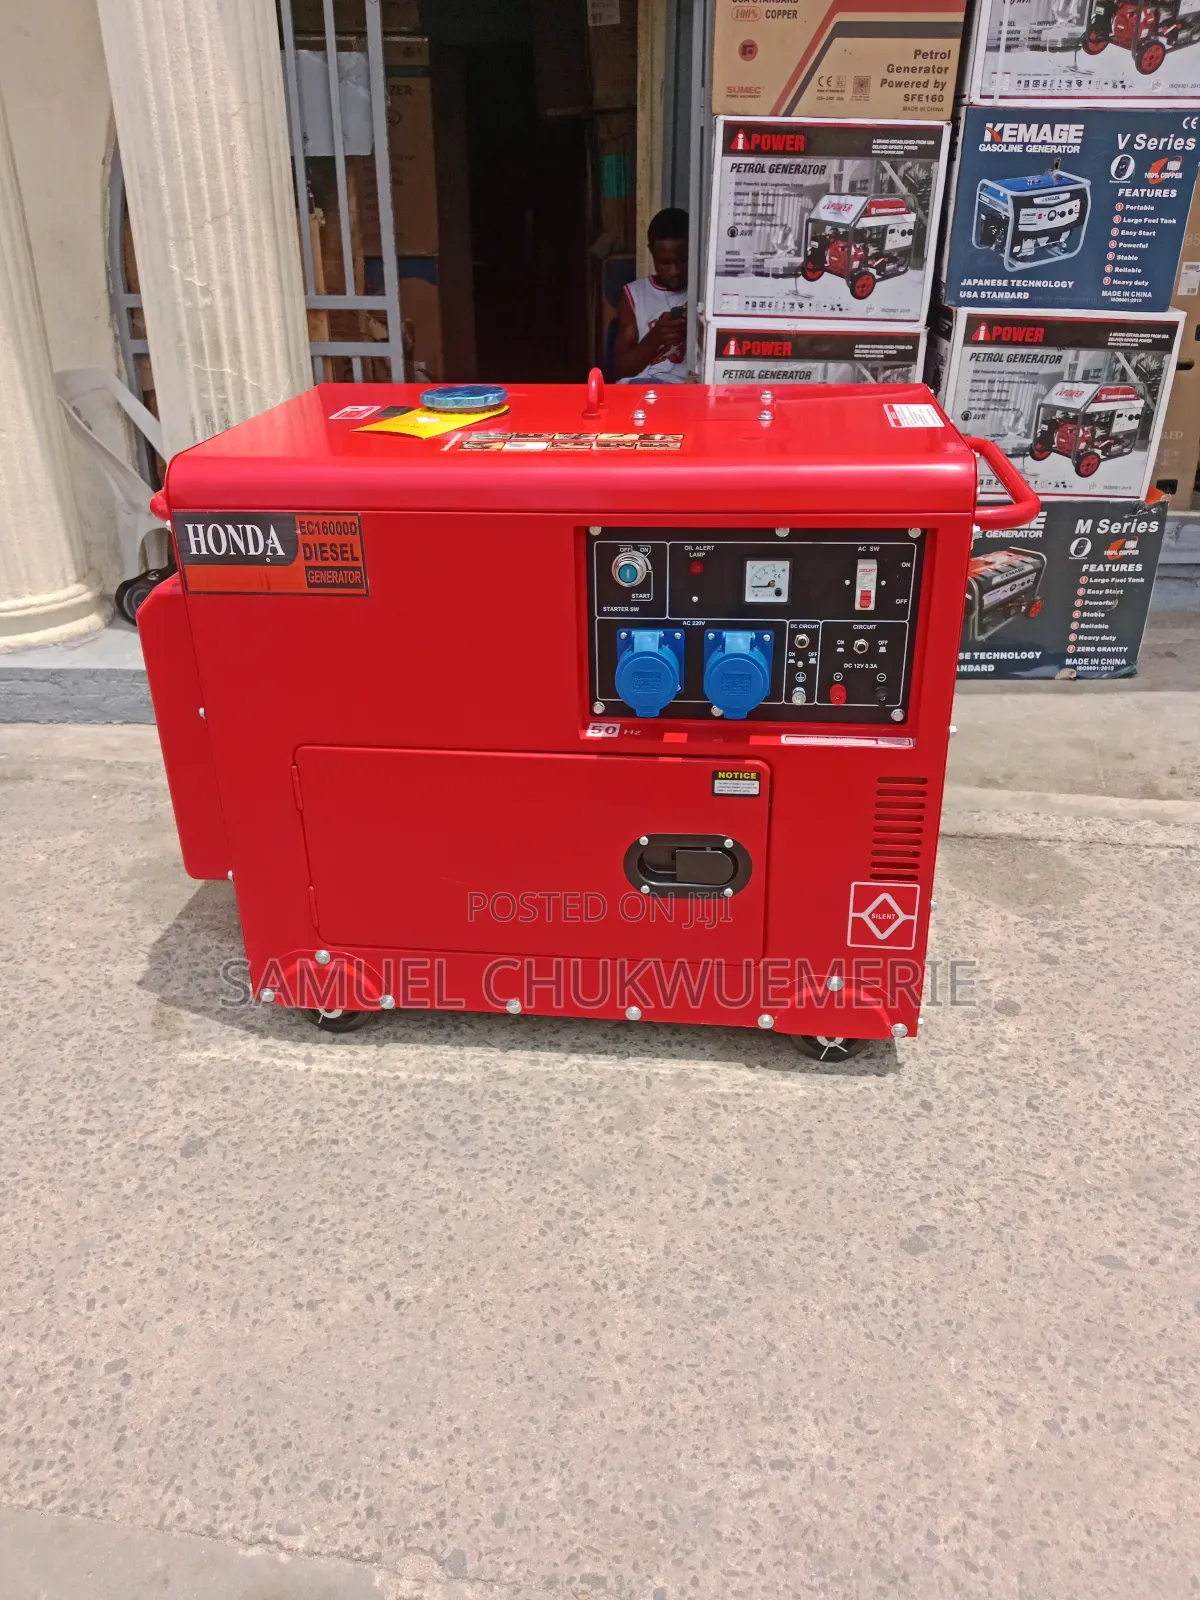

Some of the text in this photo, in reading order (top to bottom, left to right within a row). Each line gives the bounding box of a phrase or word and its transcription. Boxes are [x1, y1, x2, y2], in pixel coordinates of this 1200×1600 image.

[765, 9, 798, 19] COPPER
[913, 49, 951, 60] Petrol
[886, 63, 949, 74] Generator
[390, 85, 412, 95] ZER
[726, 86, 762, 94] SUMEC
[880, 78, 947, 91] Powered by
[903, 93, 944, 102] SFE160
[983, 122, 1085, 144] KEMAGE
[1117, 133, 1196, 150] V Series
[978, 143, 1081, 154] GASOLINE GENERATOR
[730, 163, 827, 176] PETROL GENERATOR
[1118, 188, 1178, 198] FEATURES
[960, 279, 1074, 288] JAPANESE TECHNOLOGY
[959, 291, 1030, 300] USA STANDARD
[969, 352, 1063, 365] PETROL GENERATOR
[722, 369, 812, 380] PETROL GENERATOR
[300, 520, 358, 536] EC16000D
[1074, 518, 1160, 534] M Series
[184, 523, 286, 556] HONDA
[985, 530, 1043, 538] GENERATOR
[302, 542, 360, 562] DIESEL
[1082, 564, 1143, 572] FEATURES
[308, 570, 362, 584] GENERATOR
[973, 651, 1042, 660] TECHNOLOGY
[590, 725, 617, 736] 50
